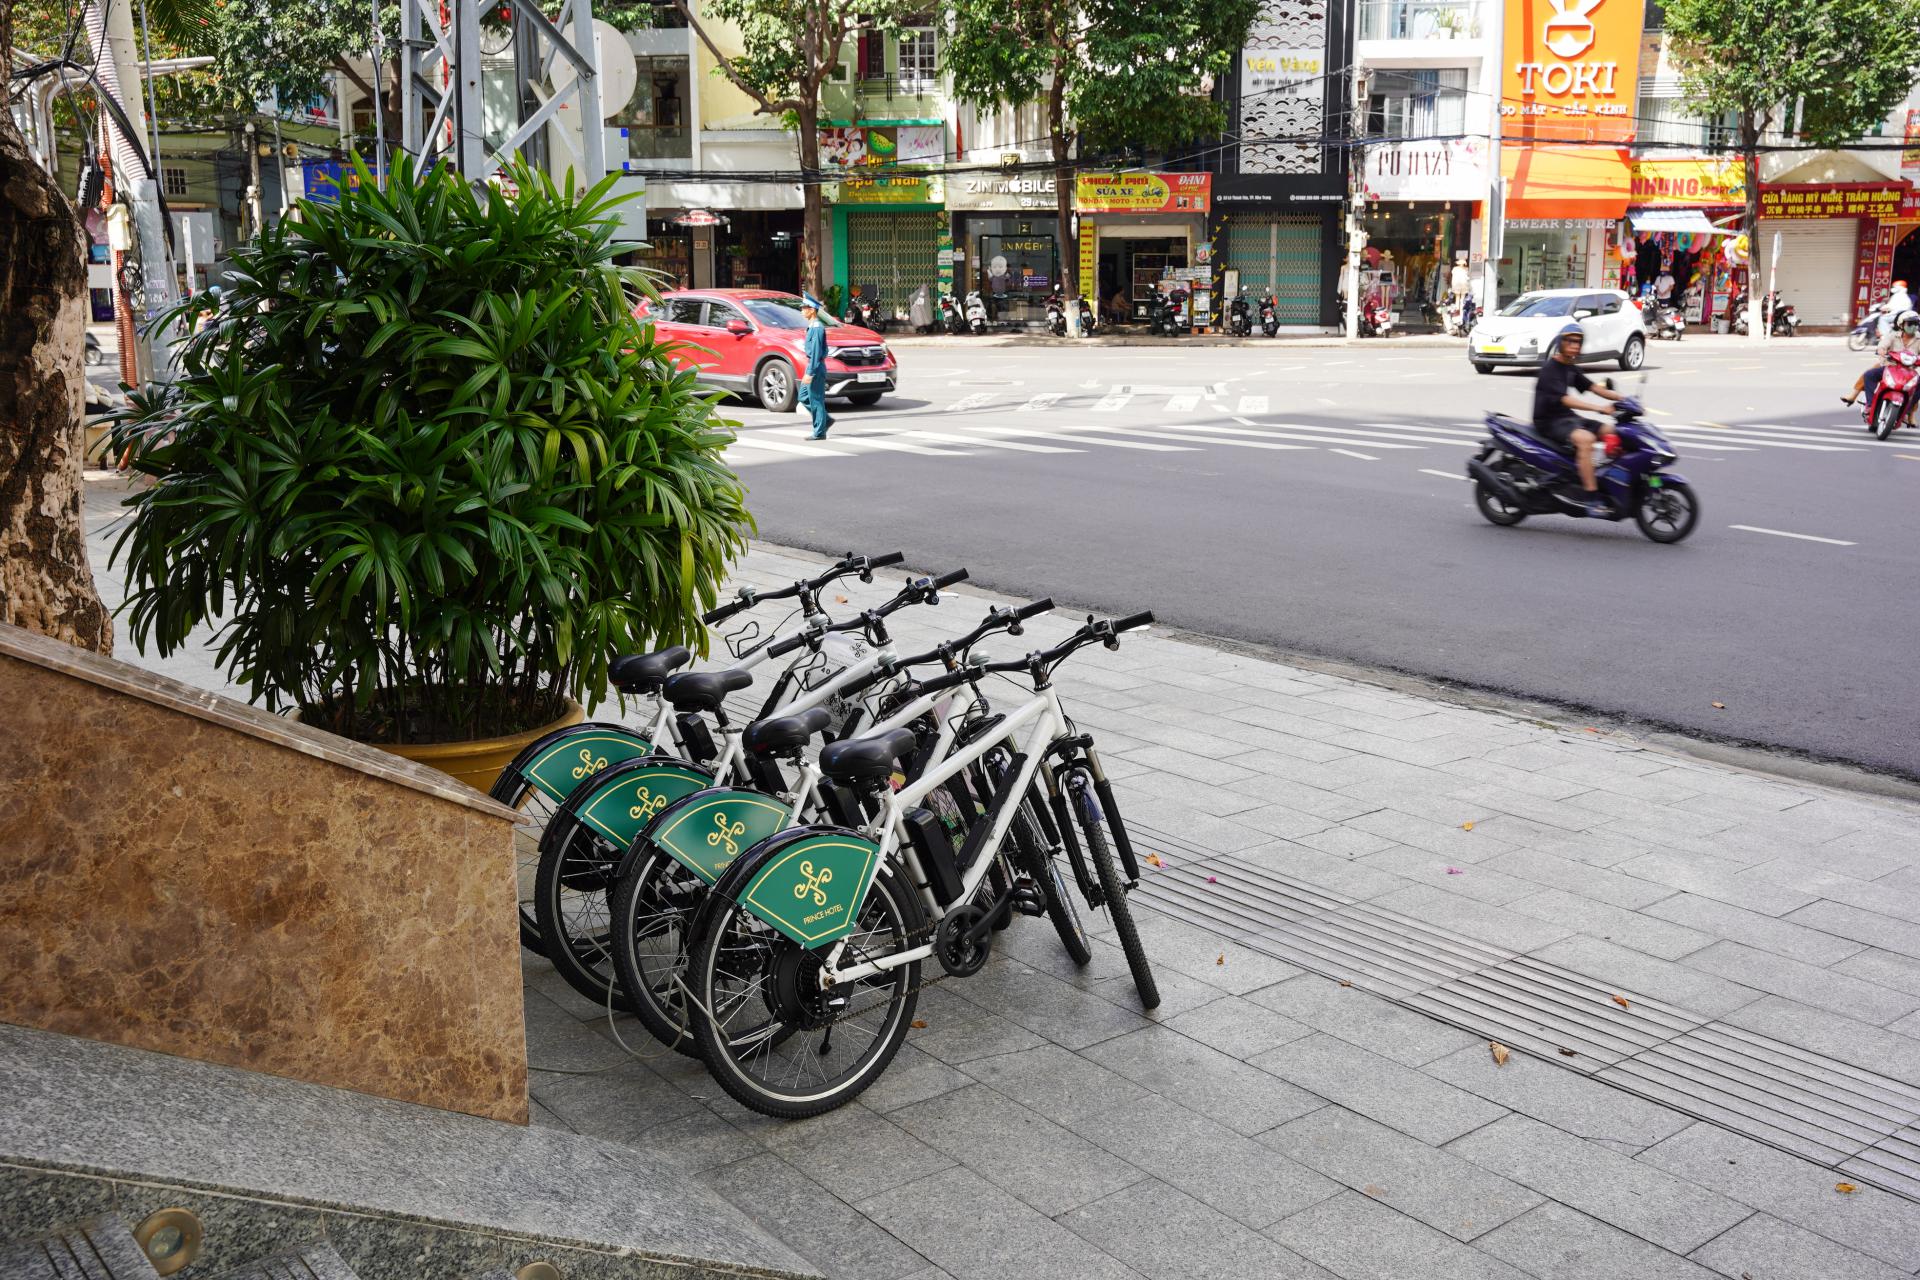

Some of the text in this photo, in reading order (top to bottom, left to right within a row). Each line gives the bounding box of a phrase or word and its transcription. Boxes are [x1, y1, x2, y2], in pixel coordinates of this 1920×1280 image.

[1247, 55, 1319, 75] Yến Vàng
[1516, 62, 1616, 95] TOKI
[1631, 177, 1699, 197] NHUNG
[1564, 219, 1617, 229] STORE
[803, 903, 844, 925] PRINCE HOTEL
